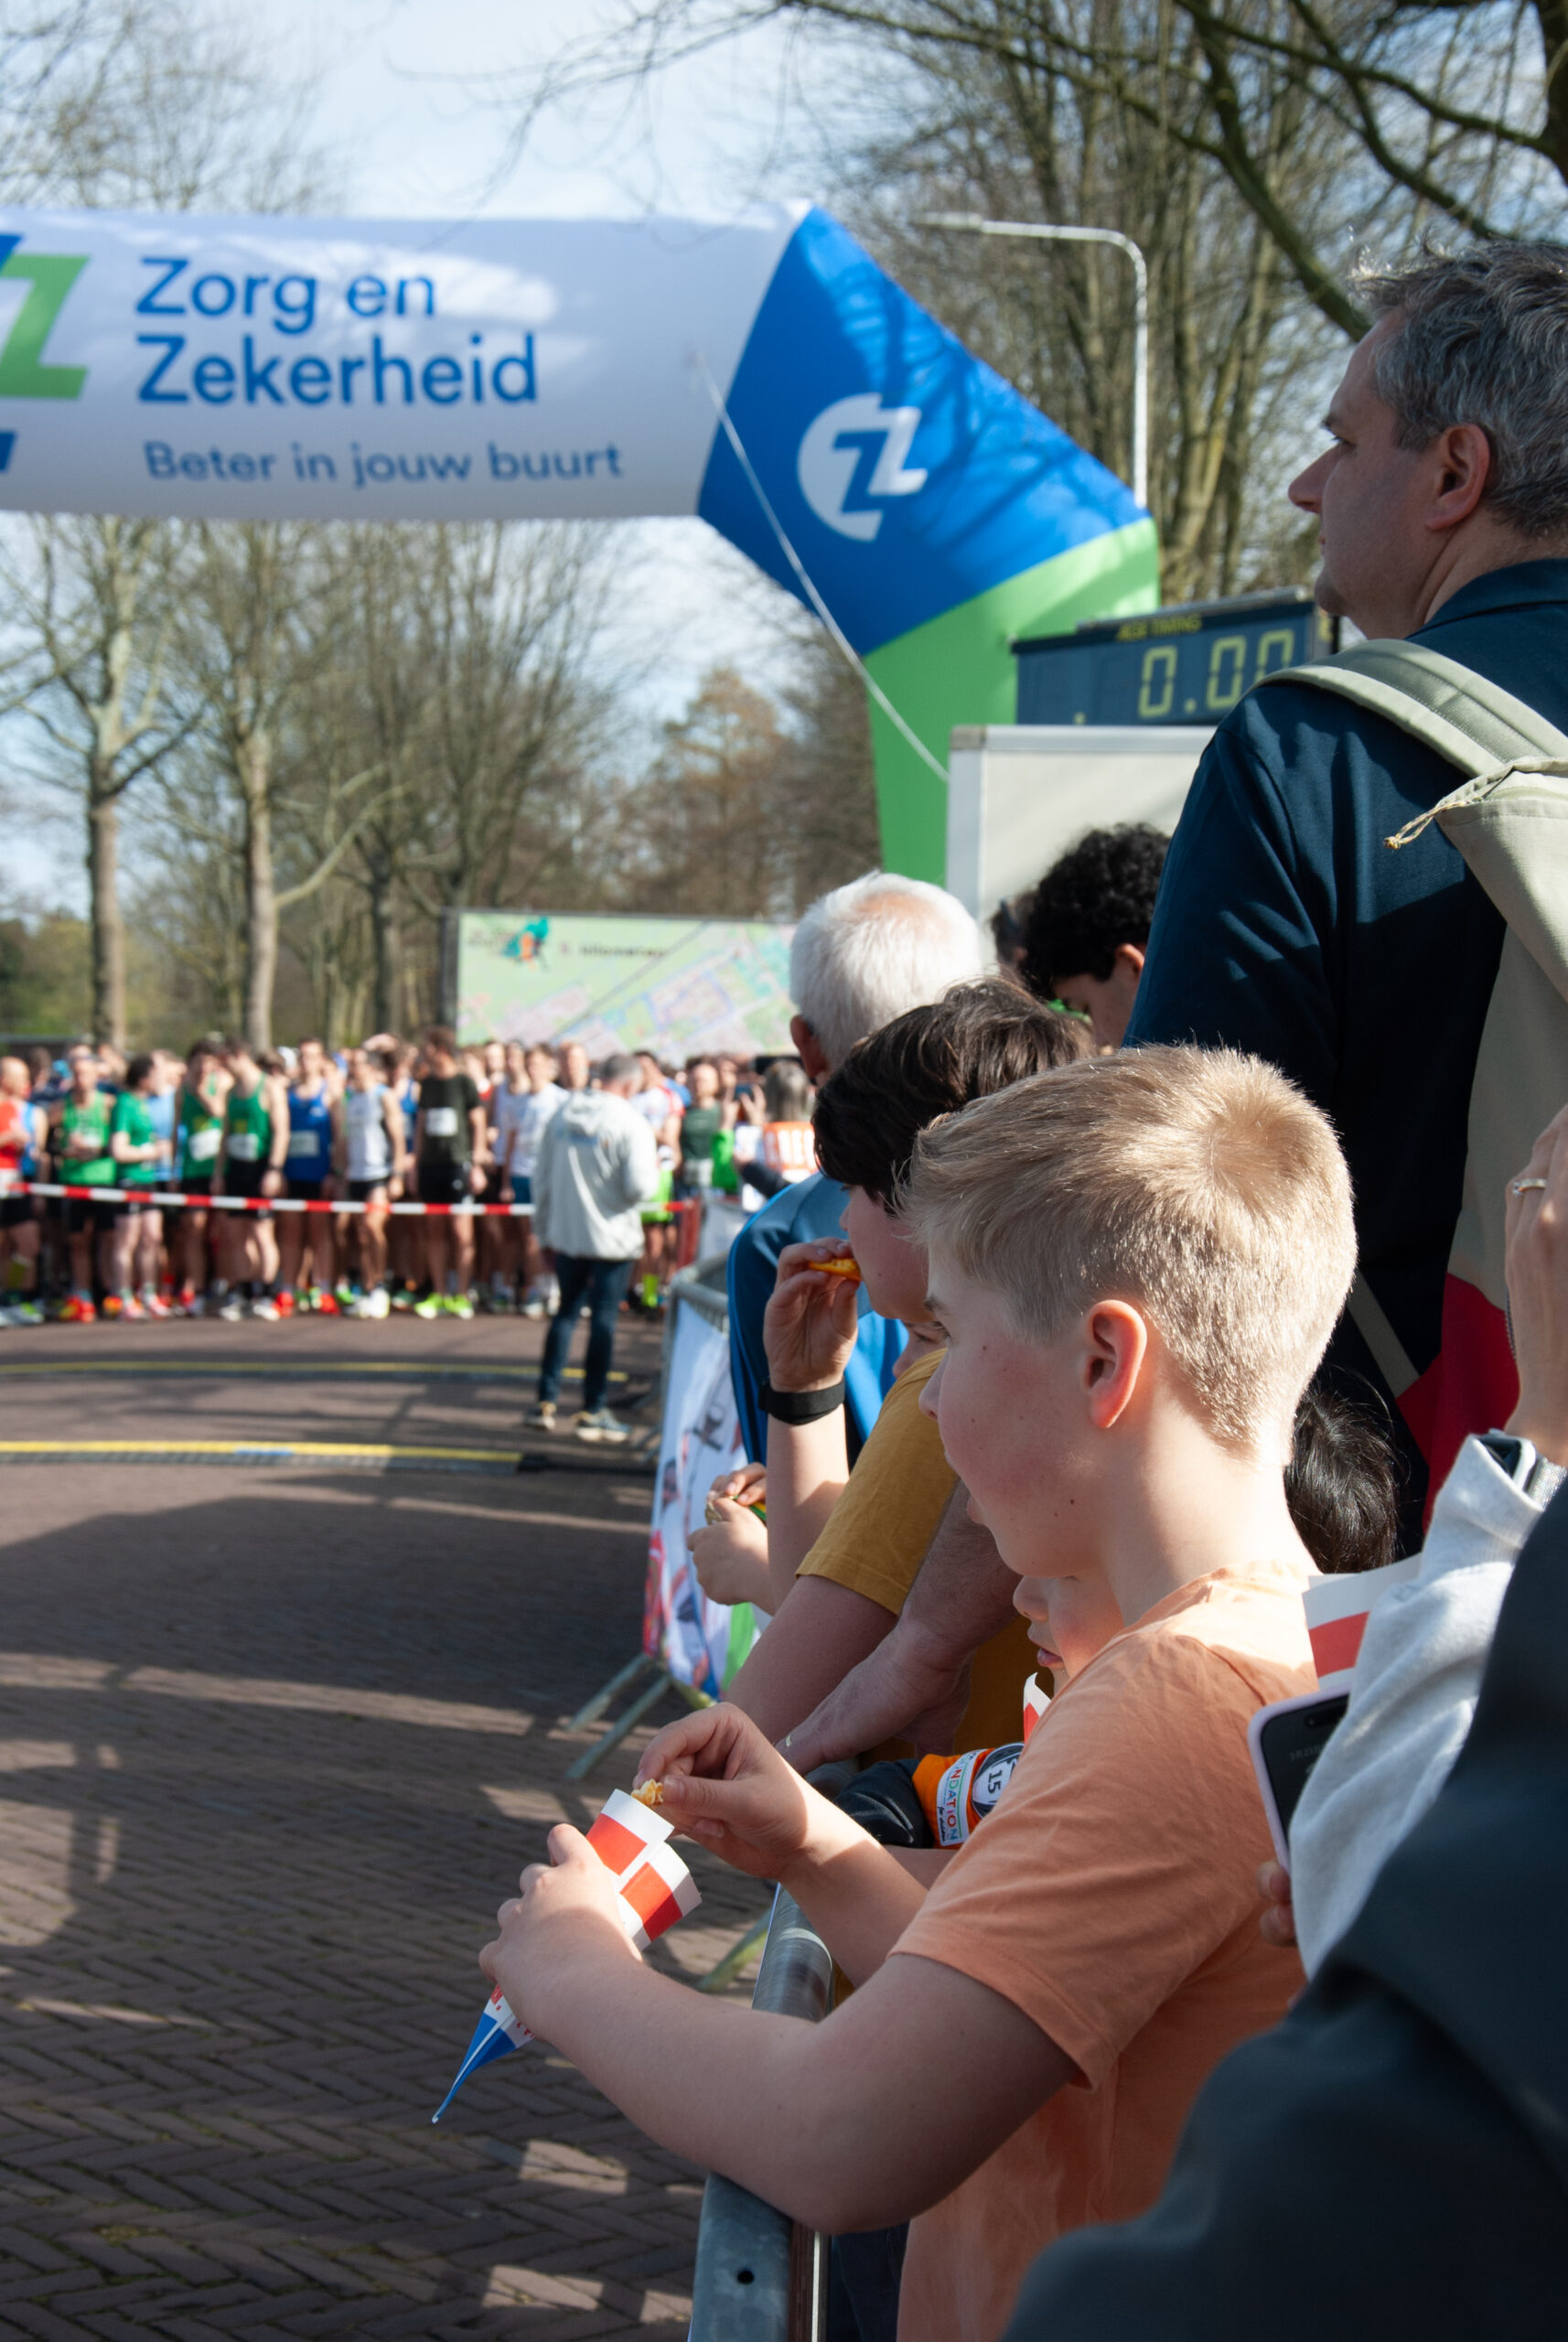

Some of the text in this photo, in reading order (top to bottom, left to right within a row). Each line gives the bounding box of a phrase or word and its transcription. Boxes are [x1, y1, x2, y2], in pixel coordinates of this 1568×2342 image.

[136, 257, 435, 335] Zorg en
[136, 333, 537, 406] Zekerheid
[143, 439, 623, 489] Beter in jouw buurt
[988, 1769, 1002, 1793] 15
